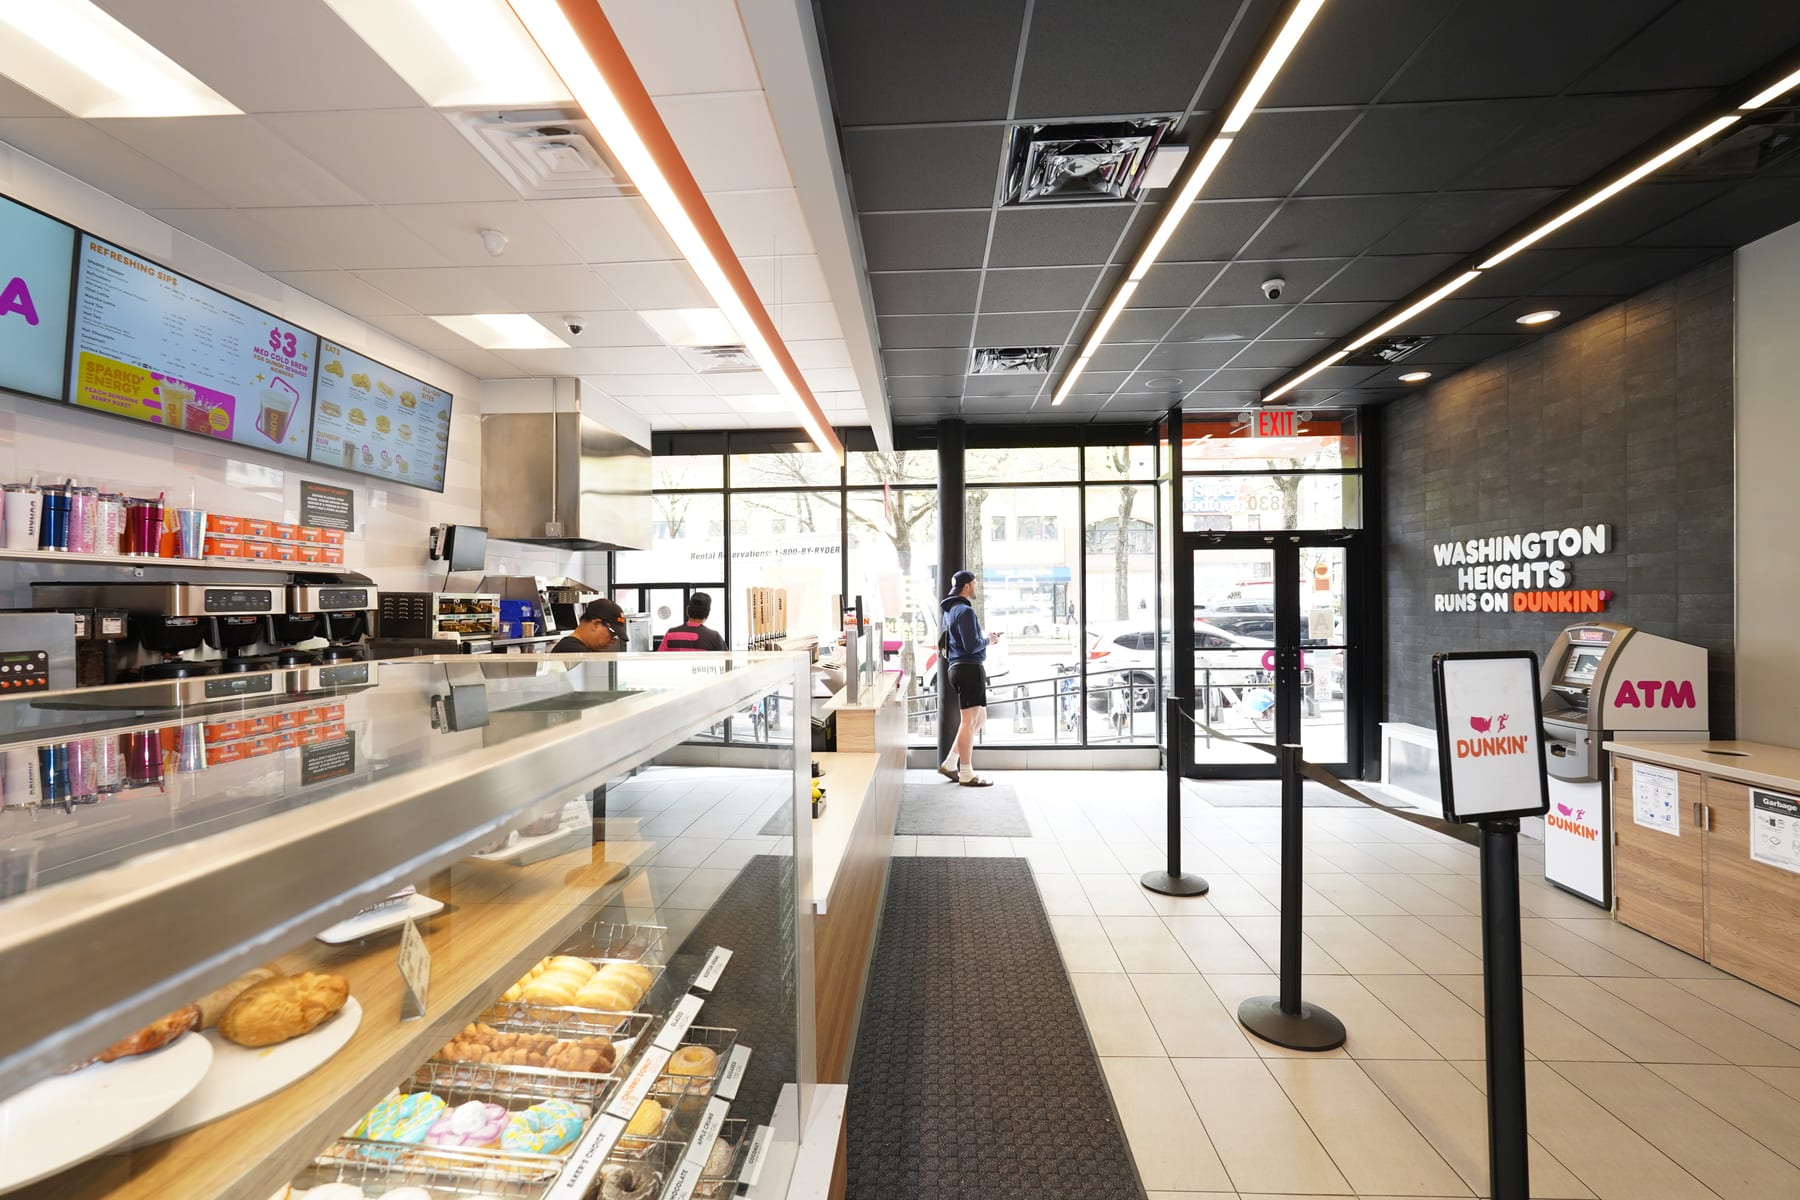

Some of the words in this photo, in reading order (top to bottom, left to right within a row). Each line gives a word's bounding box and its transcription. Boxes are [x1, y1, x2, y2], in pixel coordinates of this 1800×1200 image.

[90, 242, 155, 276] REFRESHING
[157, 271, 178, 286] SIPS
[0, 276, 39, 326] A
[268, 327, 297, 358] $3
[253, 346, 268, 357] MED
[271, 353, 289, 364] COLD
[291, 360, 308, 371] BREW
[85, 373, 140, 395] ENERGY
[1259, 412, 1294, 437] EXIT
[718, 550, 772, 559] Rervations:
[1433, 524, 1608, 566] WASHINGTON
[1458, 561, 1569, 591] HEIGHTS
[1434, 593, 1476, 613] RUNS
[1480, 592, 1508, 613] ON
[1512, 589, 1611, 613] DUNKIN'
[1614, 680, 1696, 708] ATM
[1456, 736, 1528, 759] DUNKIN'
[1762, 798, 1798, 812] Garbage
[1548, 814, 1599, 842] DUNKIN'
[696, 1129, 707, 1144] APPLE
[703, 1112, 714, 1128] CRUMB
[567, 1158, 589, 1187] BAKER'S
[586, 1132, 605, 1158] CHOICE
[748, 1142, 760, 1163] COCONUT
